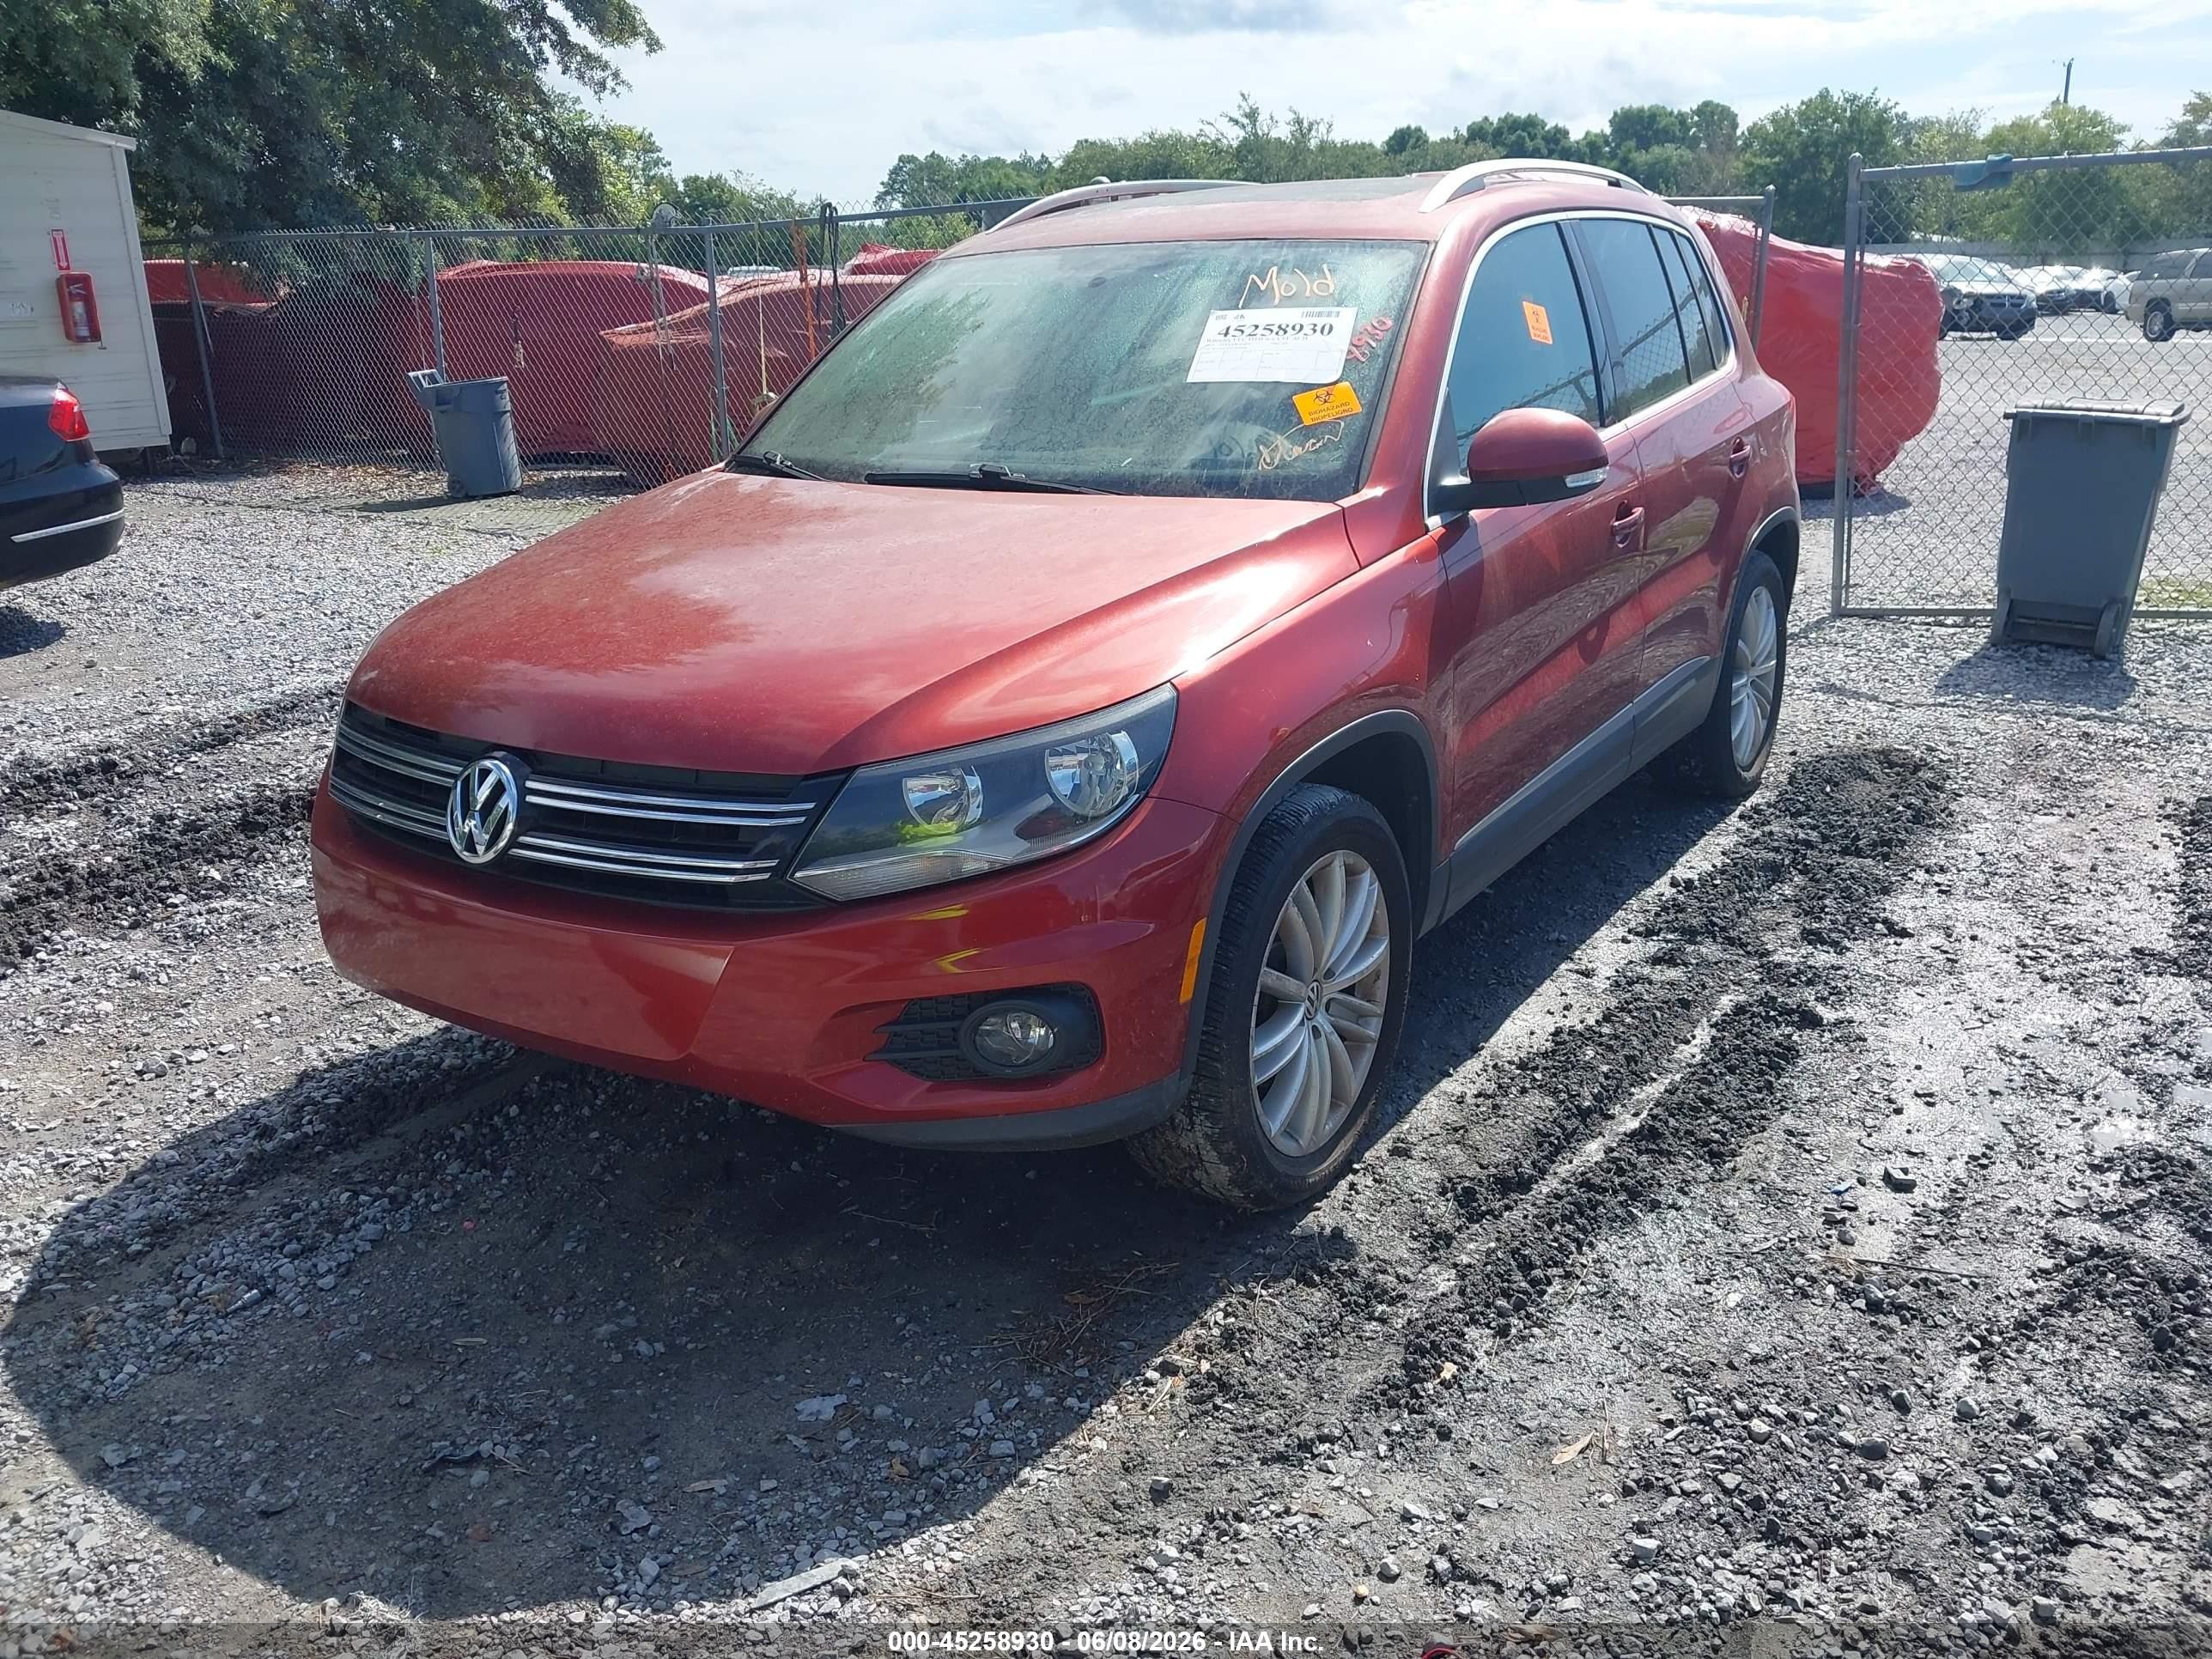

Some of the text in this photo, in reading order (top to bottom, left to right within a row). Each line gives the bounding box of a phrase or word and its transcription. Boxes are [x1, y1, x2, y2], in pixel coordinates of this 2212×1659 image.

[1238, 264, 1335, 308] Mold
[1218, 322, 1334, 337] 45258930
[1308, 401, 1350, 416] BIOHAZARD
[1310, 407, 1353, 422] BIOPELIGRO
[447, 758, 518, 864] VW
